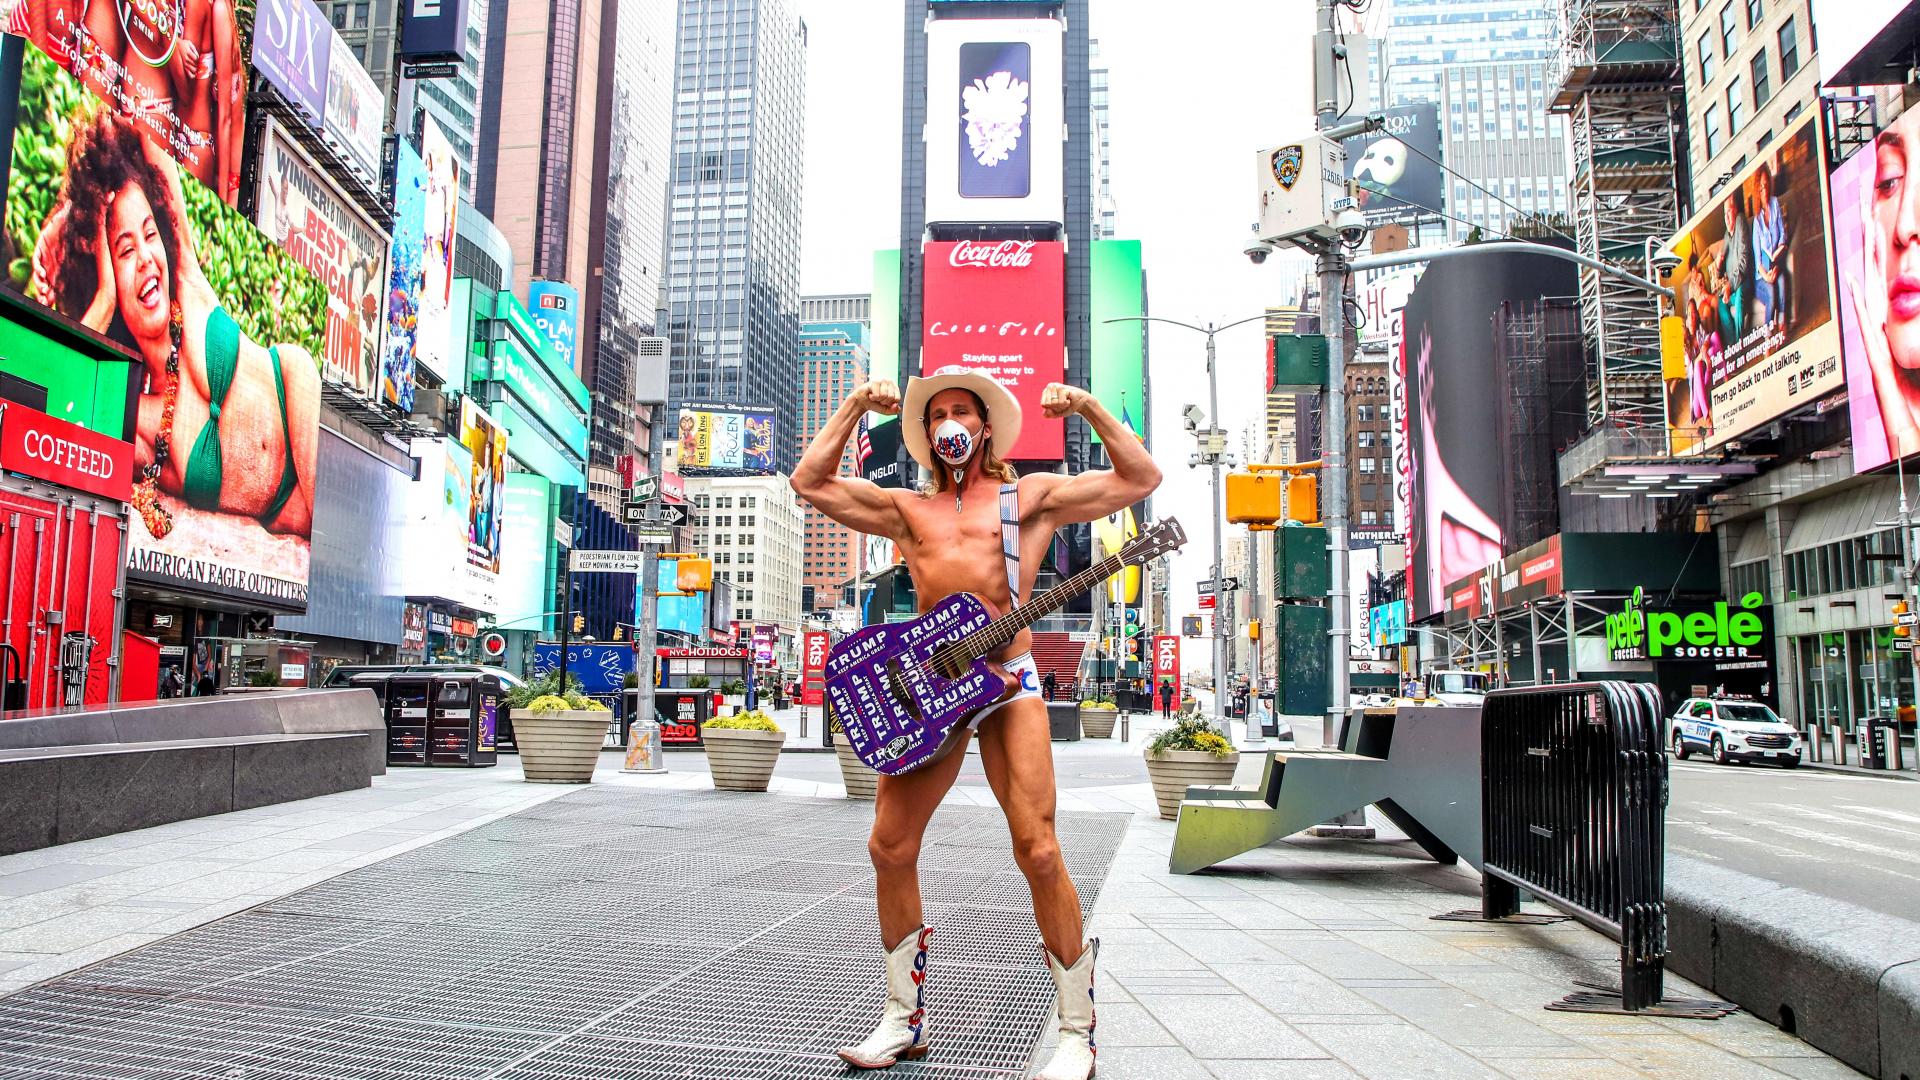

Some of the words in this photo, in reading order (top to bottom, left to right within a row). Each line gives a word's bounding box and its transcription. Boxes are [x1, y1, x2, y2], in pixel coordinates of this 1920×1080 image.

[133, 15, 154, 42] SWIM
[265, 0, 320, 93] SIX
[56, 8, 65, 26] A
[68, 21, 92, 48] new
[94, 44, 134, 85] capsule
[136, 81, 181, 128] collection
[60, 38, 89, 70] from
[90, 68, 135, 112] recycled
[135, 108, 167, 139] plastic
[169, 131, 199, 165] bottles
[277, 146, 330, 217] WINNER!
[335, 203, 352, 241] TONY
[351, 222, 376, 260] AWARDS
[1333, 197, 1351, 209] NYPD
[304, 208, 347, 266] BEST
[949, 240, 1036, 268] Coca-Cola
[929, 321, 1056, 336] Coca-Cola
[1710, 350, 1724, 368] Talk
[1724, 338, 1743, 360] about
[1742, 323, 1770, 348] making
[1769, 320, 1775, 331] a
[962, 353, 997, 364] Staying
[998, 354, 1023, 363] apart
[1003, 367, 1022, 376] way
[1024, 366, 1035, 375] to
[1712, 366, 1726, 386] plan
[1726, 359, 1736, 375] for
[1736, 354, 1746, 369] an
[1746, 330, 1786, 363] emergency.
[1713, 391, 1728, 406] Then
[1728, 387, 1737, 401] go
[1737, 378, 1753, 393] back
[1754, 372, 1761, 384] to
[1762, 362, 1774, 380] not
[1774, 350, 1801, 373] talking.
[1800, 365, 1815, 381] NYC
[697, 415, 707, 432] KING
[23, 428, 114, 480] COFFEED
[697, 434, 707, 450] LION
[723, 416, 739, 465] FROZEN
[869, 462, 898, 481] INGLOT
[632, 509, 645, 518] ON
[1350, 531, 1399, 541] MOTHERL
[579, 561, 591, 569] KEEP
[580, 553, 611, 561] PEDESTRIAN
[127, 546, 206, 583] AMERICAN
[208, 562, 246, 589] EAGLE
[247, 571, 308, 603] OUTFITTERS
[432, 612, 445, 625] BLUE
[899, 602, 961, 643] TRUMP
[923, 625, 945, 641] AMERICA
[945, 616, 960, 628] GREAT
[1605, 585, 1644, 661] pelé
[1646, 591, 1764, 657] pelé
[669, 649, 687, 657] NYC
[688, 647, 742, 657] HOTDOGS
[809, 635, 826, 667] tkts
[828, 631, 887, 671] TRUMP
[837, 665, 849, 675] KEEP
[849, 653, 871, 667] AMERICA
[870, 643, 886, 655] GREAT
[1159, 638, 1176, 671] tkts
[1675, 646, 1749, 658] SOCCER
[65, 685, 81, 705] AWA
[678, 702, 696, 711] ERIKA
[851, 674, 888, 740] TRUMP
[871, 692, 885, 717] AMERICA
[922, 674, 985, 715] TRUMP
[932, 710, 945, 720] KEEP
[945, 697, 968, 713] AMERICA
[967, 688, 984, 700] GREAT
[677, 711, 696, 720] JAYNE
[830, 686, 866, 752] TRUMP
[882, 716, 891, 731] KEEP
[874, 759, 886, 769] KEEP
